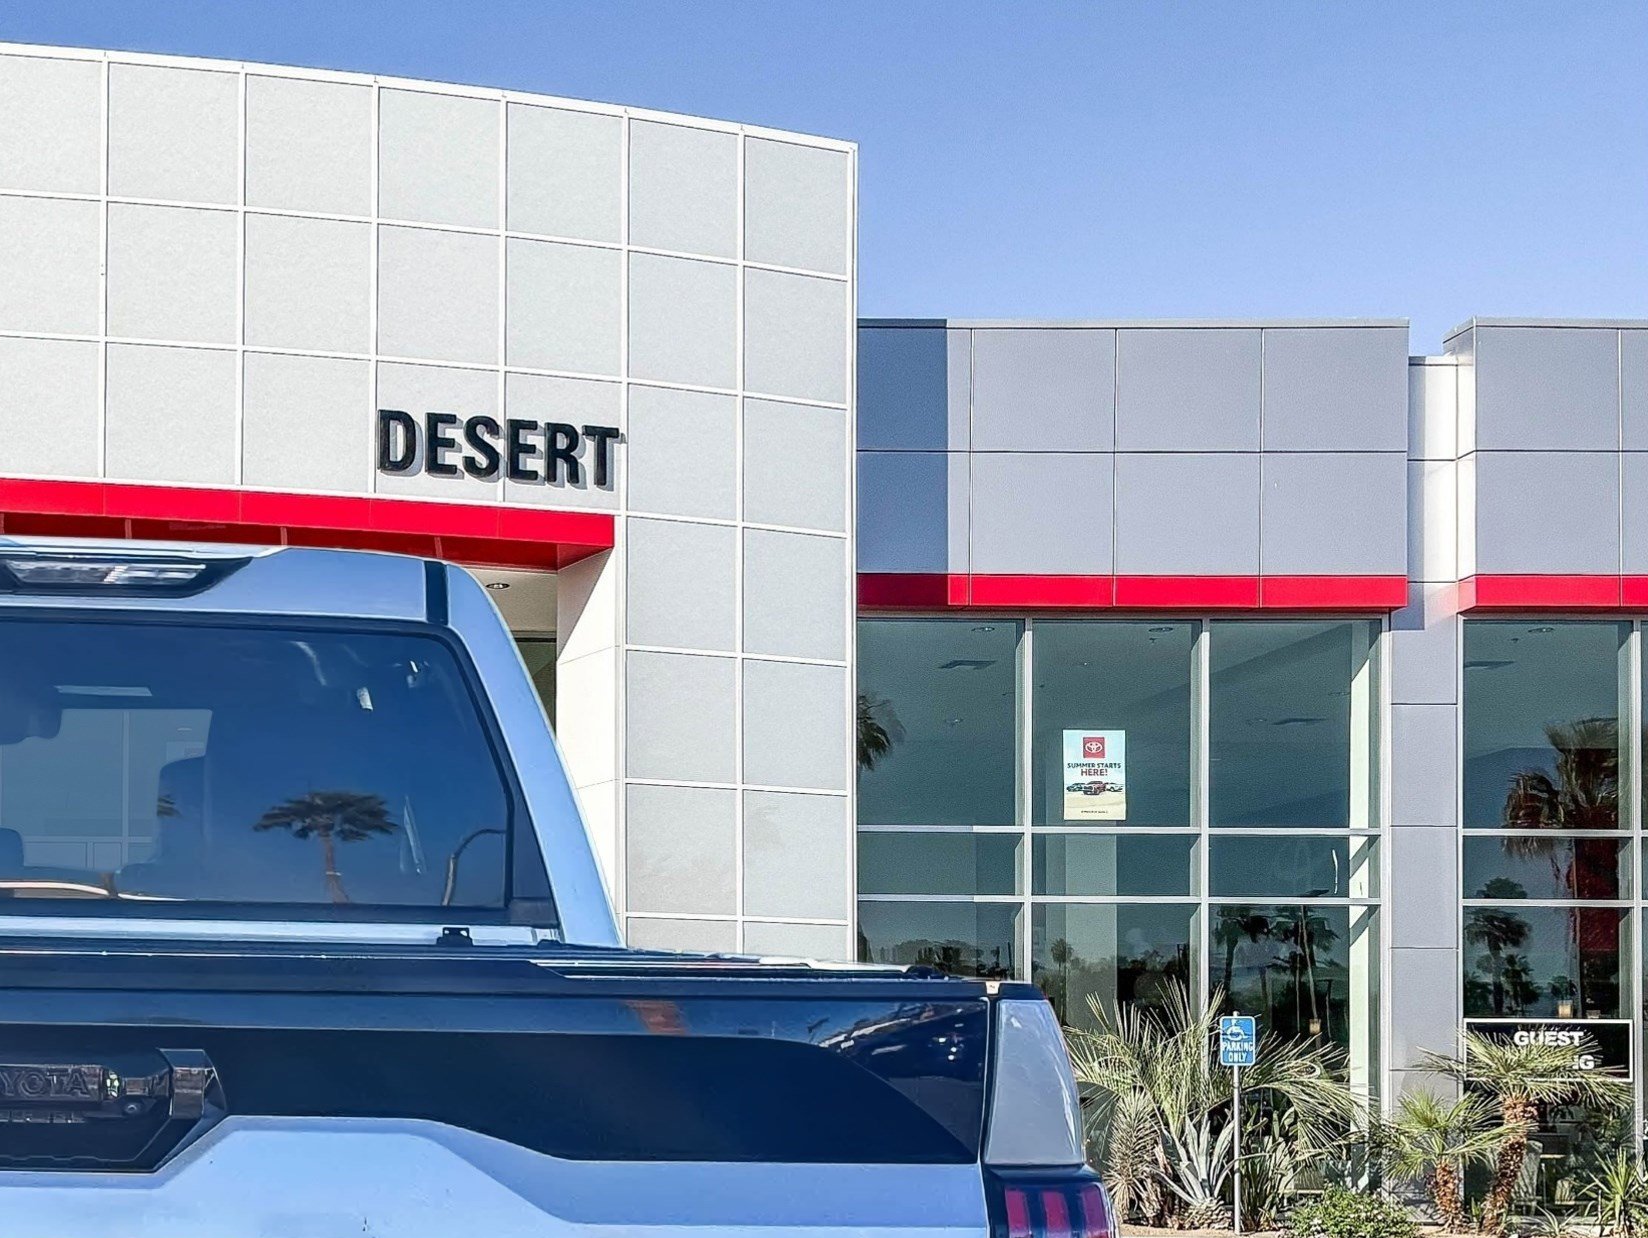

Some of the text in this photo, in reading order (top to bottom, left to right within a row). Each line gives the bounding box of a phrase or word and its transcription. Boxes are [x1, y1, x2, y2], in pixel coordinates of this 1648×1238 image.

[377, 409, 622, 488] DESERT
[1080, 768, 1108, 776] HERE!
[1513, 1030, 1584, 1046] GUEST
[1222, 1041, 1253, 1052] PARKING
[1228, 1052, 1247, 1062] ONLY
